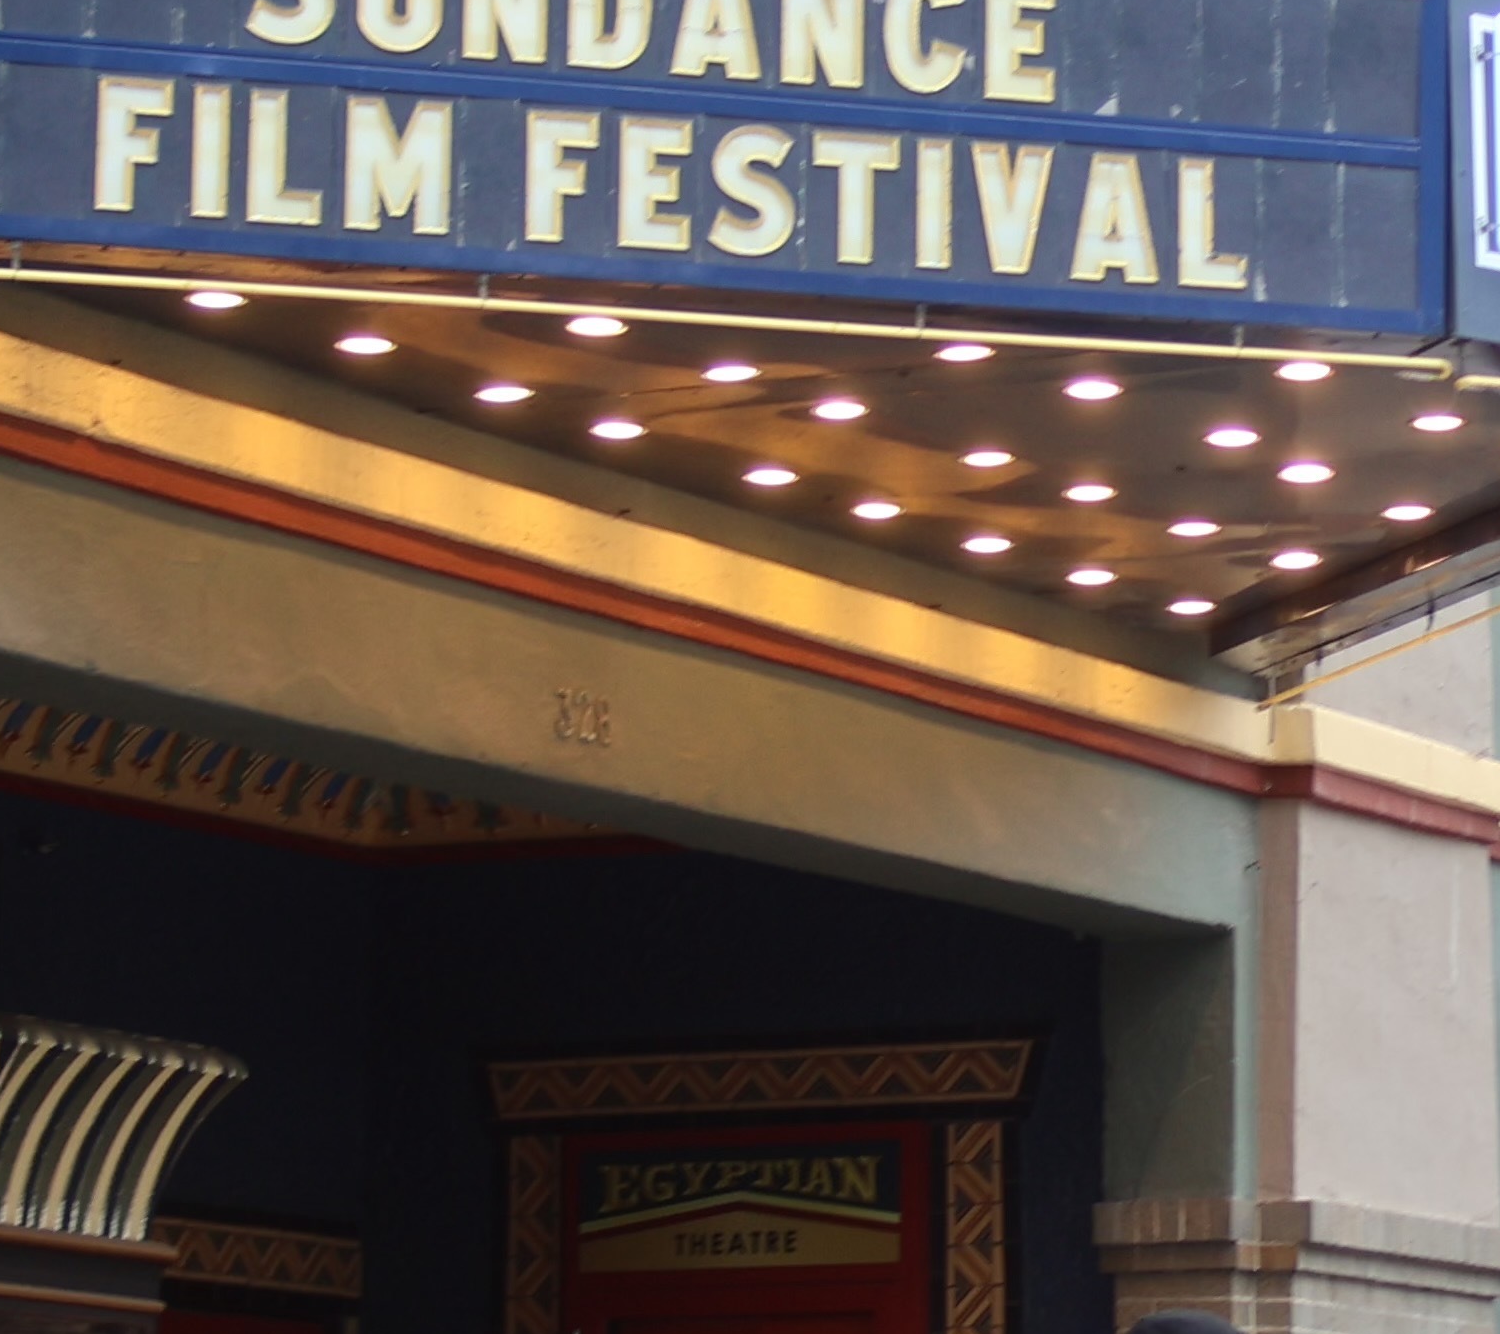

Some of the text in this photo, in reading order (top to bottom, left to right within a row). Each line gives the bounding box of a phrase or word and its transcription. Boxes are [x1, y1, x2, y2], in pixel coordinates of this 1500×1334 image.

[94, 77, 1250, 290] FILM FESTIVAL
[598, 1155, 882, 1213] EGYPTIAN
[673, 1229, 798, 1257] THEATRE
